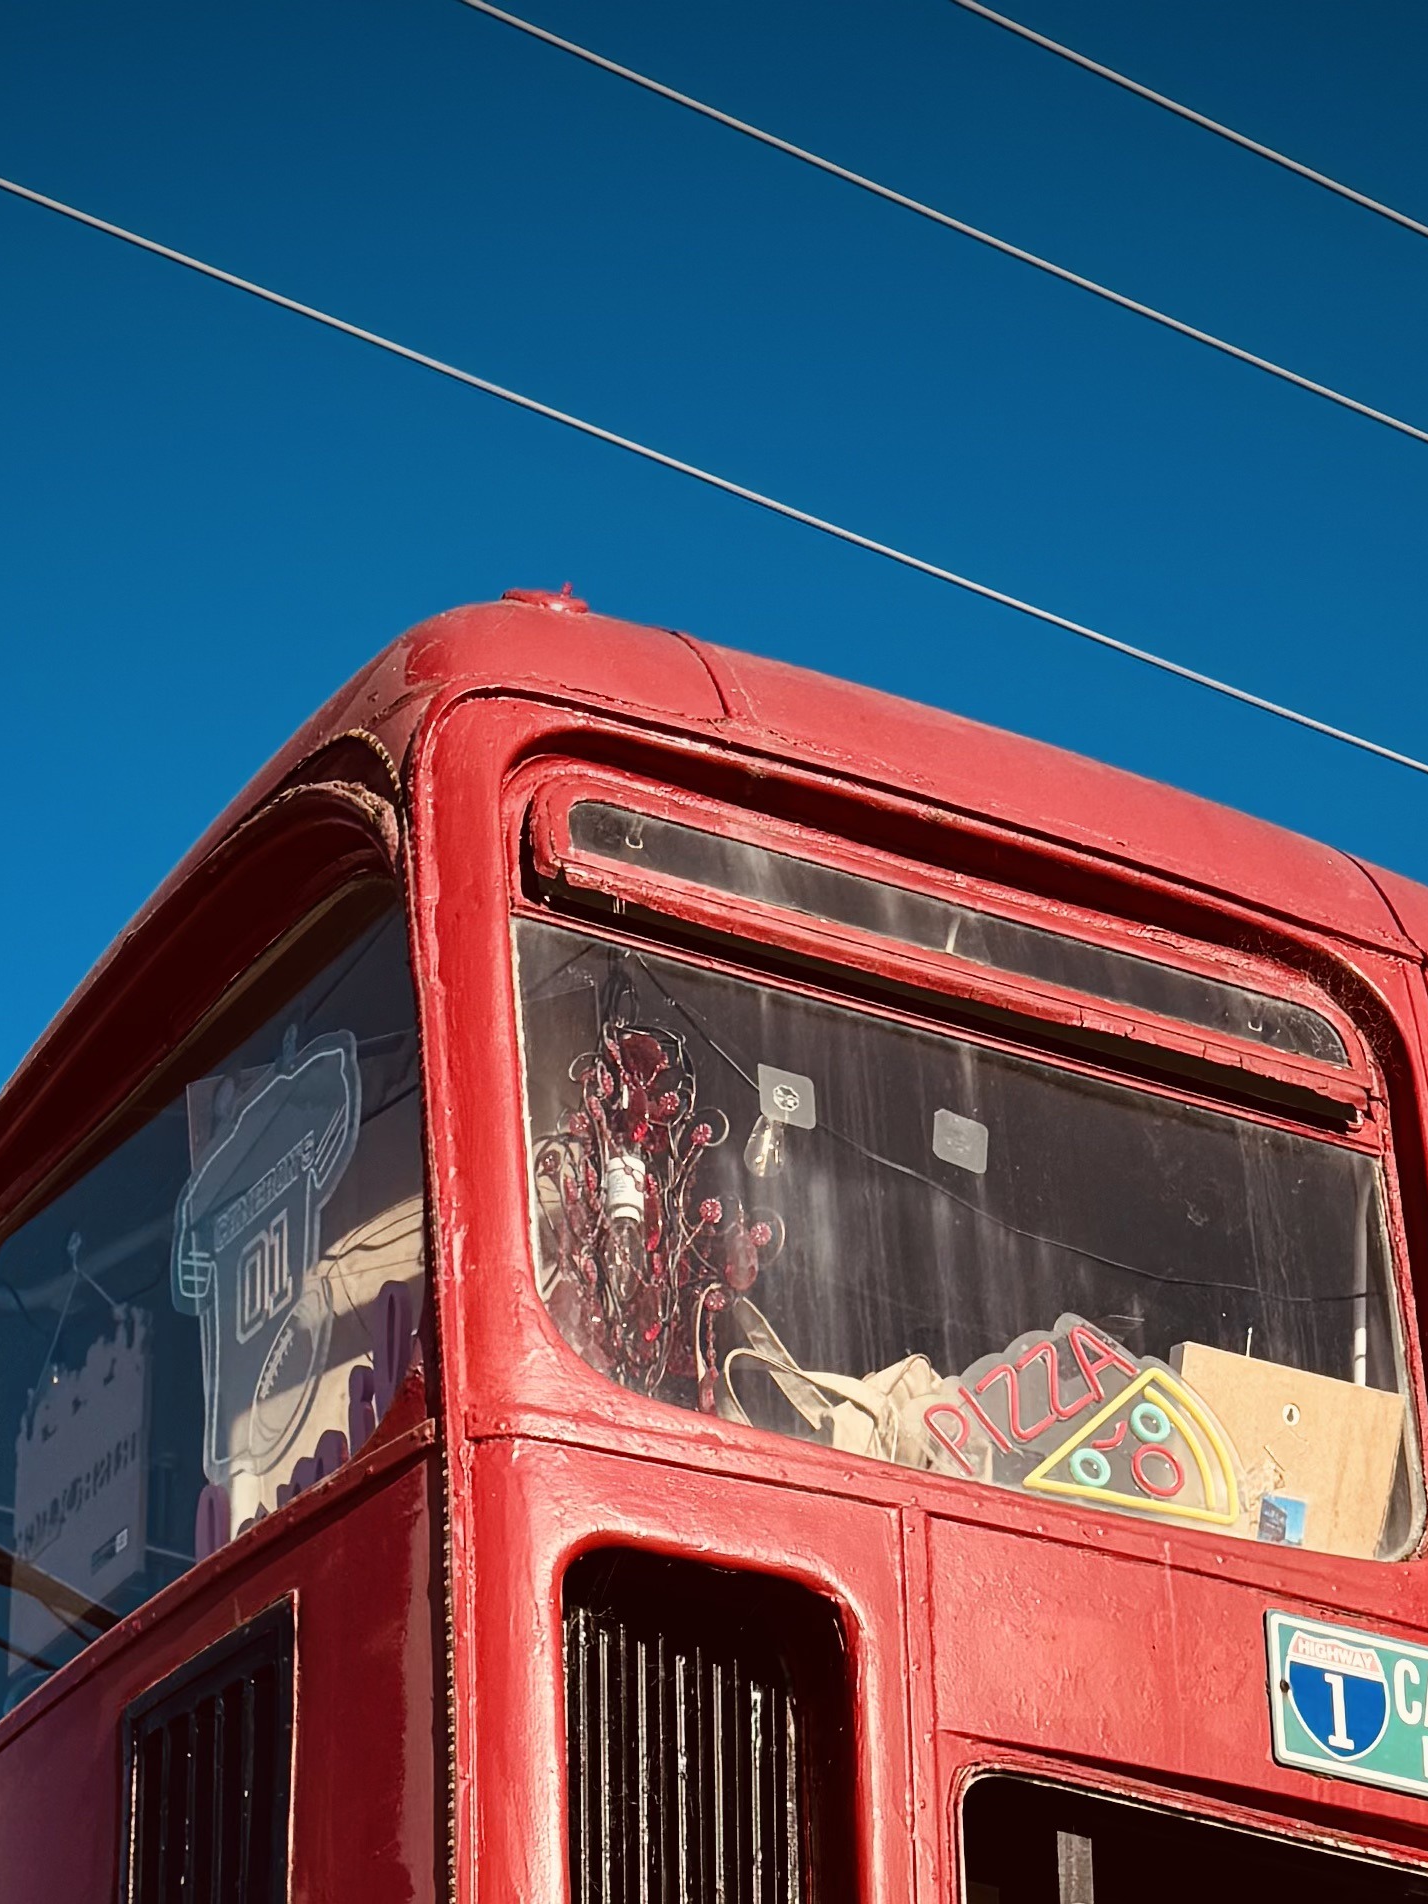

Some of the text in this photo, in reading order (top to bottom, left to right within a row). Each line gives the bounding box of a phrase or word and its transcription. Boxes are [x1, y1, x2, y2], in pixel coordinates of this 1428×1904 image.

[924, 1326, 1140, 1477] PIZZA
[1296, 1637, 1374, 1670] HIGHWAY
[1323, 1672, 1355, 1750] 1
